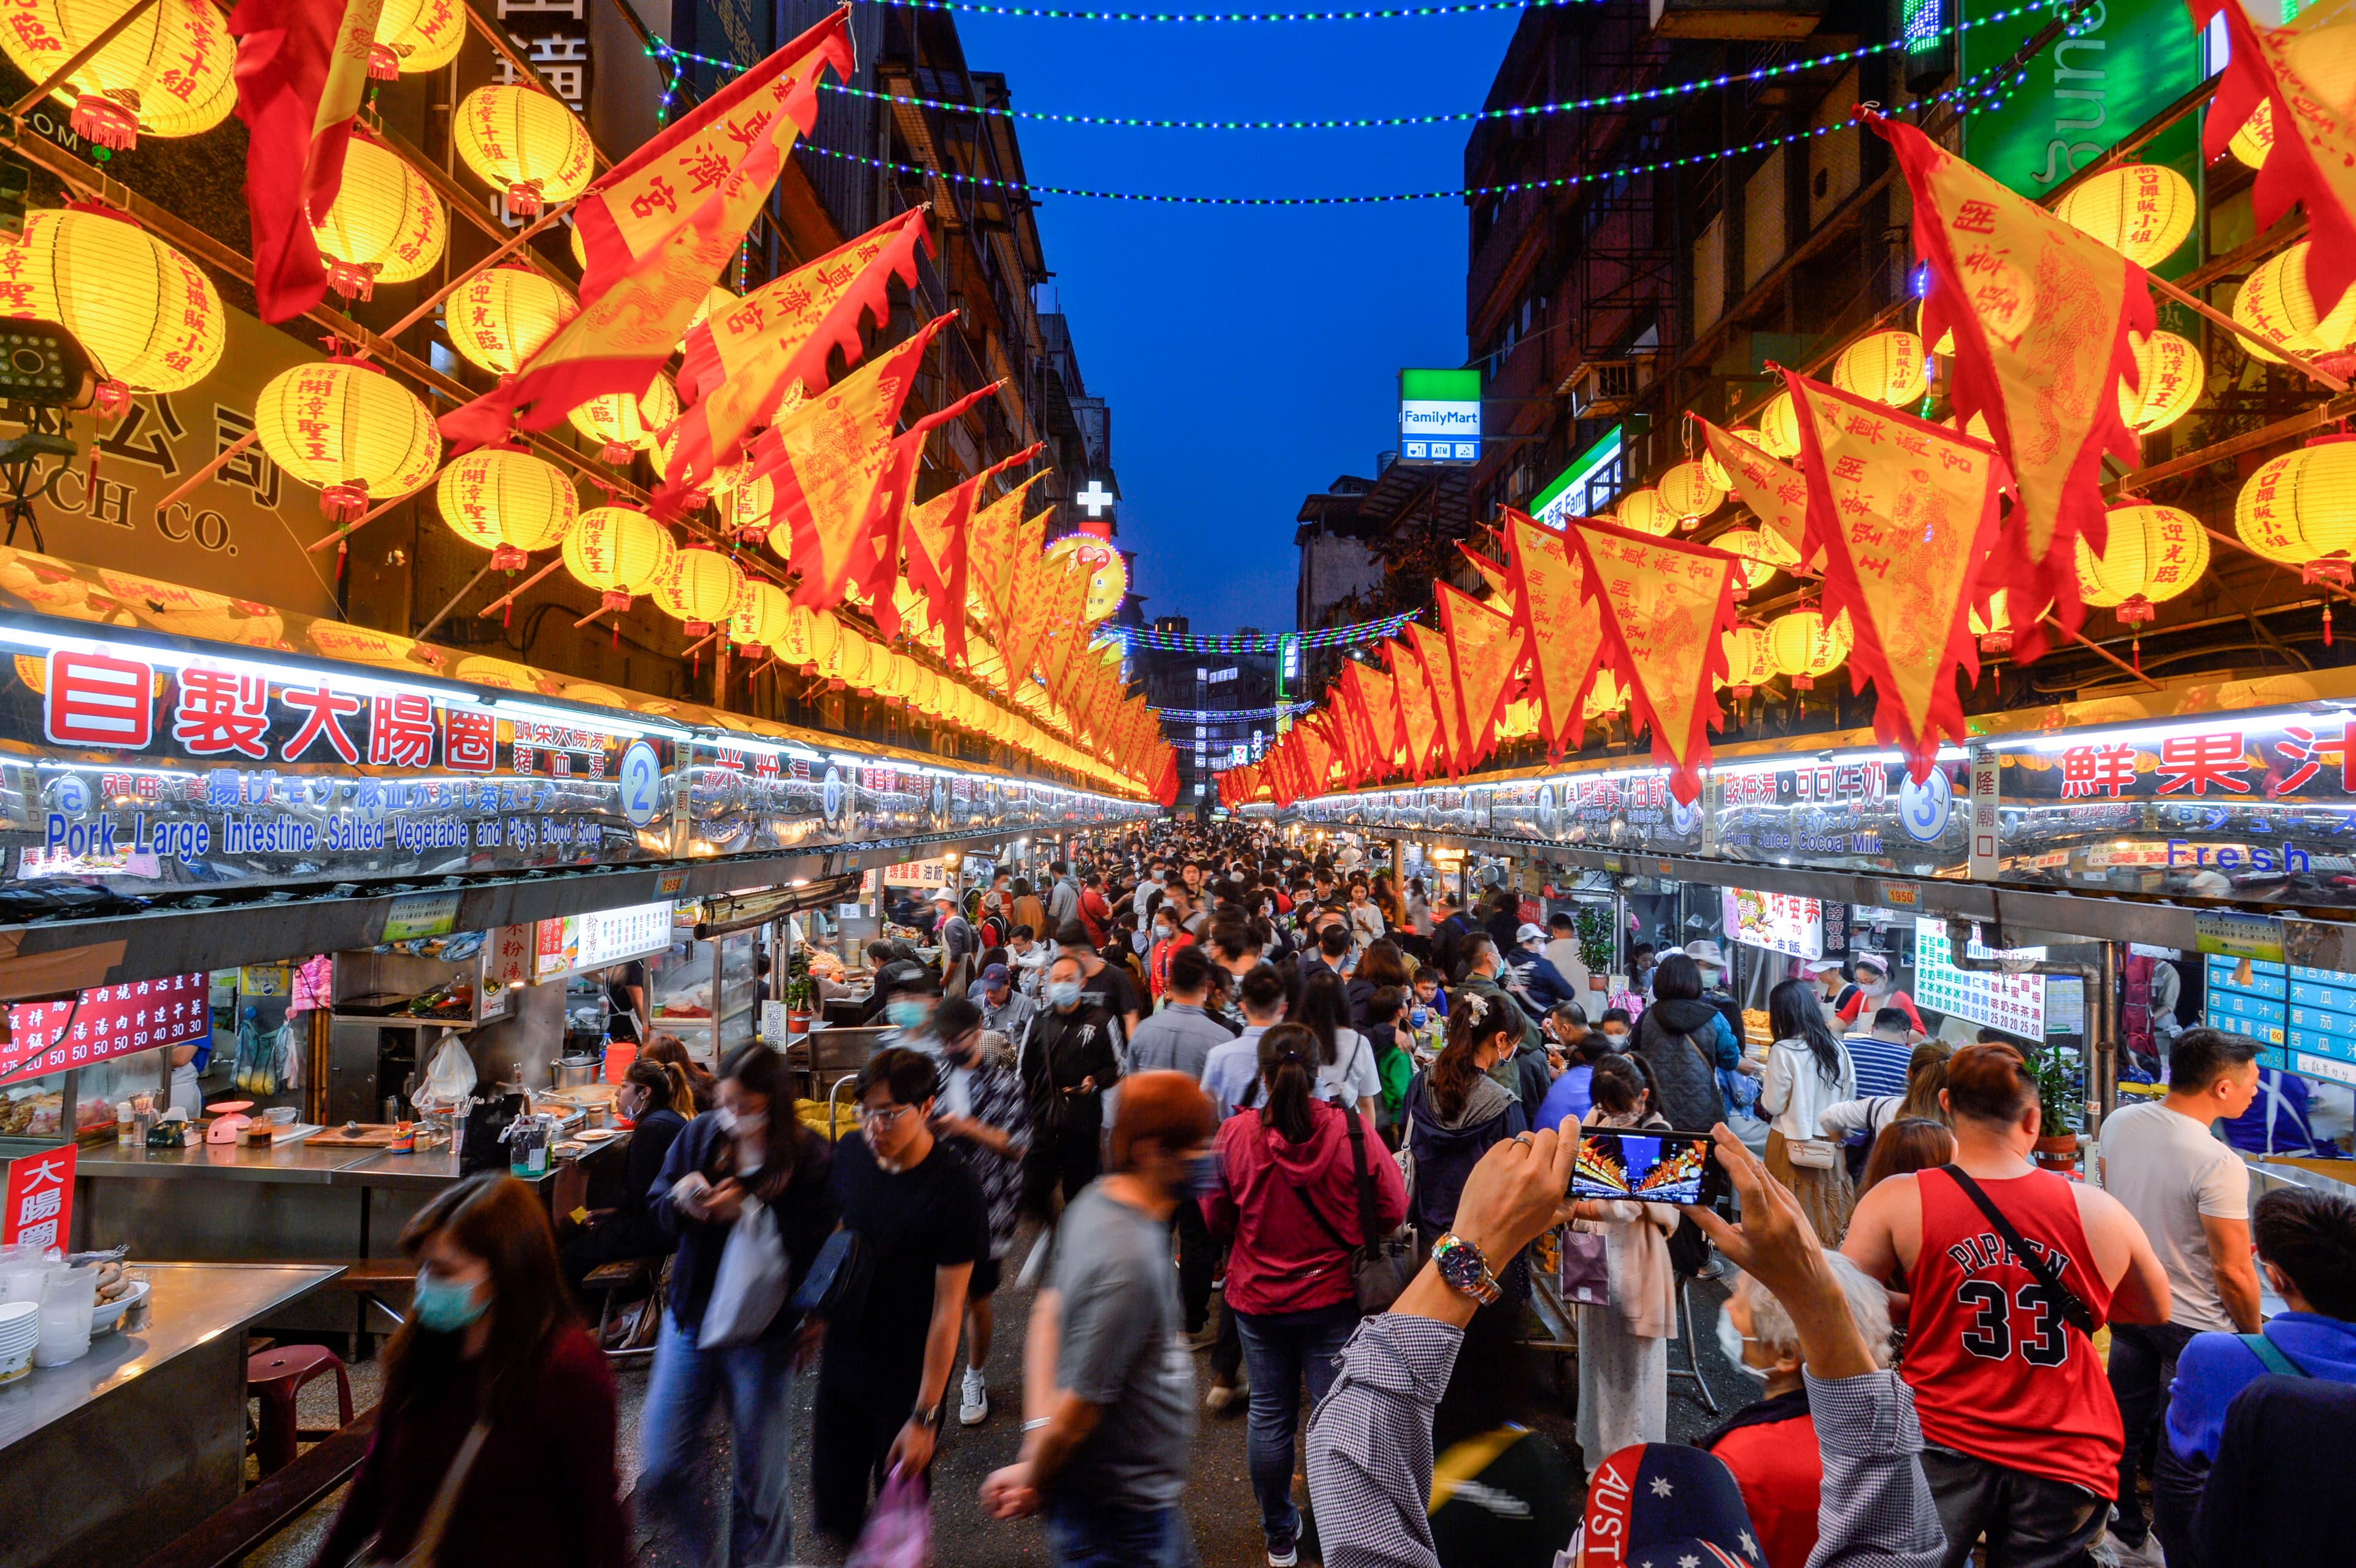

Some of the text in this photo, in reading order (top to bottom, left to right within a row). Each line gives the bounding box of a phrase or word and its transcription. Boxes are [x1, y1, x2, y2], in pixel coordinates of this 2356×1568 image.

[20, 113, 77, 151] OM
[2128, 167, 2160, 244] 廟口攤販小組
[726, 263, 857, 335] 奠濟宮
[2147, 342, 2185, 409] 開漳聖王
[297, 379, 339, 463] 開漳聖王
[1405, 410, 1477, 426] FamilyMart
[1434, 447, 1447, 455] ATM
[460, 469, 497, 535] 開漳聖王
[2254, 458, 2294, 548] 廟口攤販小組
[155, 500, 238, 557] CO.
[583, 519, 609, 574] 開漳聖王
[2155, 509, 2187, 583] 歡迎光臨
[52, 647, 494, 771] 自製大腸圈
[514, 747, 604, 779] 豬血湯
[2061, 722, 2356, 798] 鮮果汁
[714, 747, 810, 796] 米粉湯
[632, 759, 649, 810] 2
[828, 778, 837, 813] 6
[1913, 778, 1936, 828] 3
[1976, 746, 1996, 858] 基隆廟口
[1542, 794, 1549, 818] 7
[48, 813, 115, 858] Pork
[135, 813, 209, 863] Large
[395, 816, 467, 853] Vegetable
[477, 818, 501, 847] and
[509, 818, 536, 851] Pig's
[542, 817, 572, 845] Blood
[578, 817, 602, 848] Soup
[1725, 829, 1752, 846] Plum
[1852, 834, 1884, 855] Milk
[2167, 839, 2309, 873] Fresh
[889, 863, 943, 881] 螃蟹羹 油飯
[662, 878, 682, 893] 1950
[1889, 890, 1915, 904] 1950
[542, 920, 554, 953] 粉湯
[585, 915, 598, 951] 粉湯
[1792, 924, 1802, 936] 70
[1774, 936, 1801, 955] 油飯
[2211, 970, 2270, 994] 奇異汁
[1918, 992, 1925, 1004] 70
[1927, 994, 1934, 1006] 30
[1934, 997, 1942, 1008] 30
[1944, 999, 1951, 1011] 30
[1953, 1002, 1960, 1013] 30
[2210, 992, 2269, 1018] 西瓜汁
[1961, 1004, 1969, 1017] 30
[1971, 1007, 1979, 1019] 30
[1981, 1010, 1988, 1021] 50
[1990, 1012, 1998, 1024] 25
[171, 1023, 185, 1037] 30
[189, 1019, 201, 1033] 30
[2000, 1016, 2008, 1028] 20
[2010, 1018, 2018, 1030] 20
[2020, 1021, 2028, 1033] 25
[2031, 1024, 2039, 1037] 20
[114, 1035, 128, 1050] 50
[134, 1031, 148, 1046] 50
[153, 1027, 167, 1041] 40
[2271, 1031, 2282, 1041] 60
[72, 1044, 88, 1061] 50
[93, 1040, 108, 1056] 50
[50, 1050, 65, 1066] 50
[1958, 1280, 2069, 1367] 33
[1588, 1462, 1630, 1563] AUST
